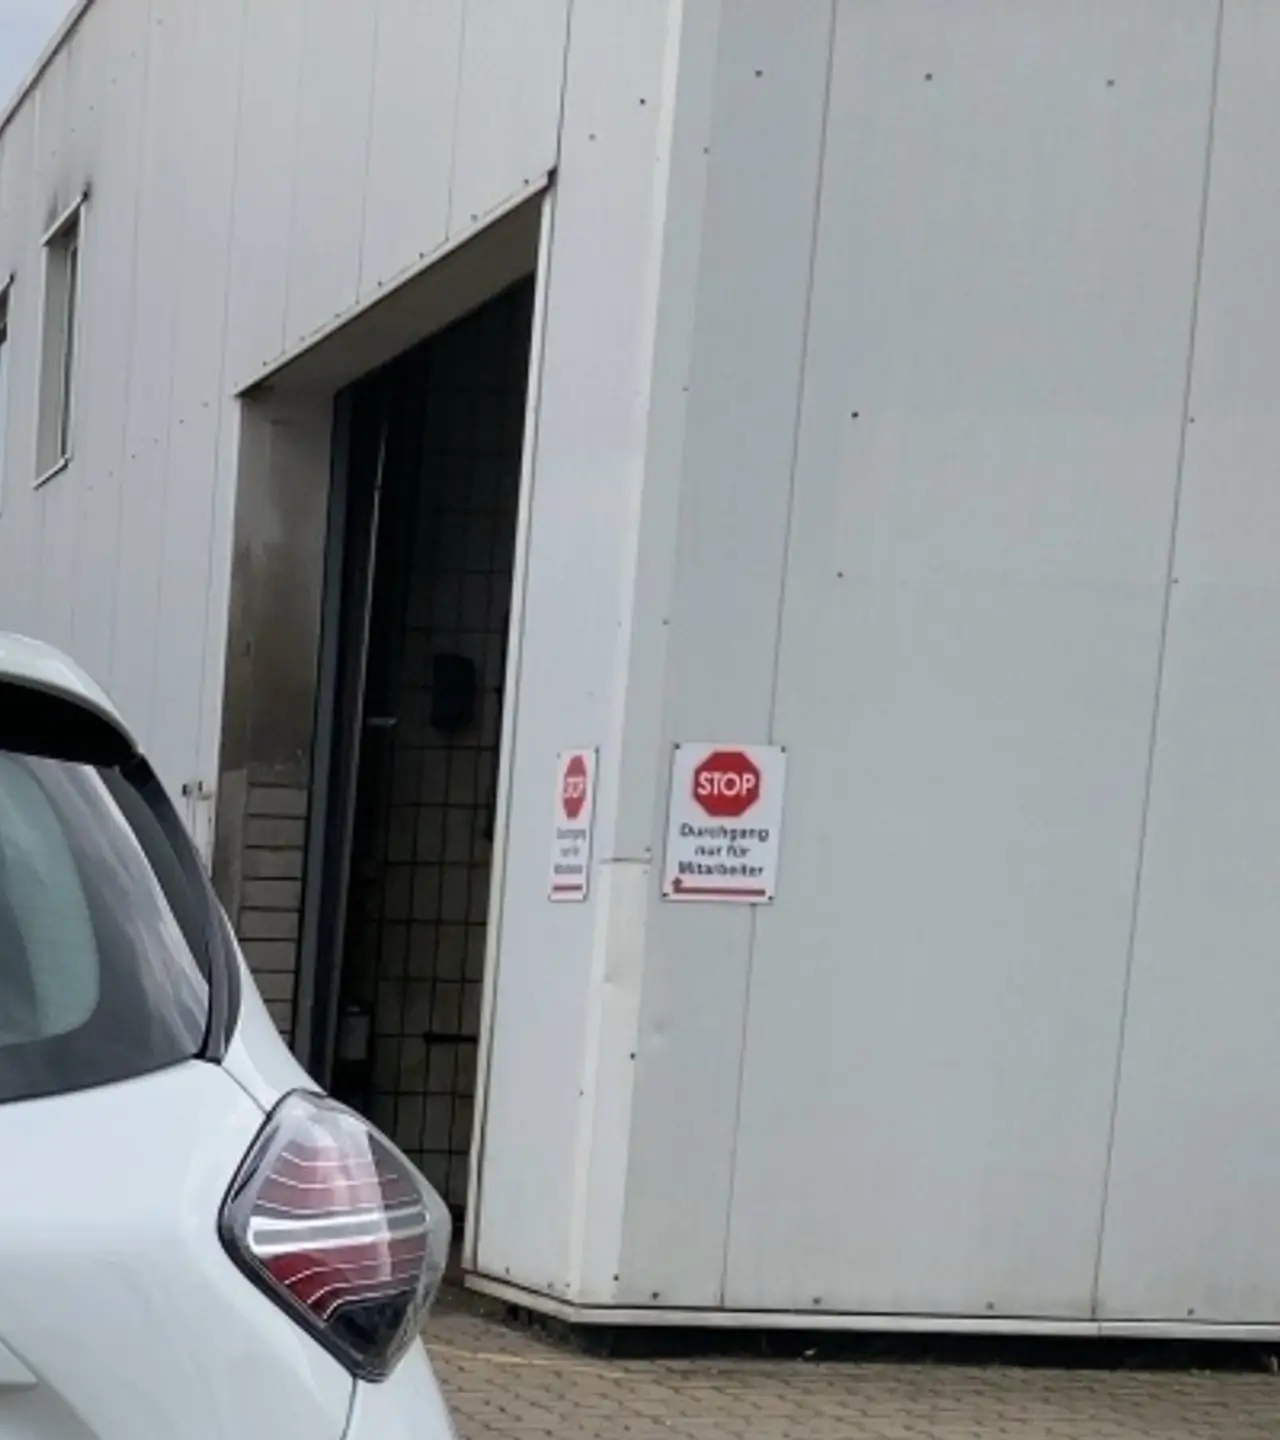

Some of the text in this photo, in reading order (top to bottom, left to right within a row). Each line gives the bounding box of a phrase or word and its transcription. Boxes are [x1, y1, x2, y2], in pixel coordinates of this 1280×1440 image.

[697, 771, 757, 797] STOP
[680, 822, 770, 843] Durchgang
[694, 844, 751, 858] nur für
[677, 861, 764, 877] Mitarbeiter
